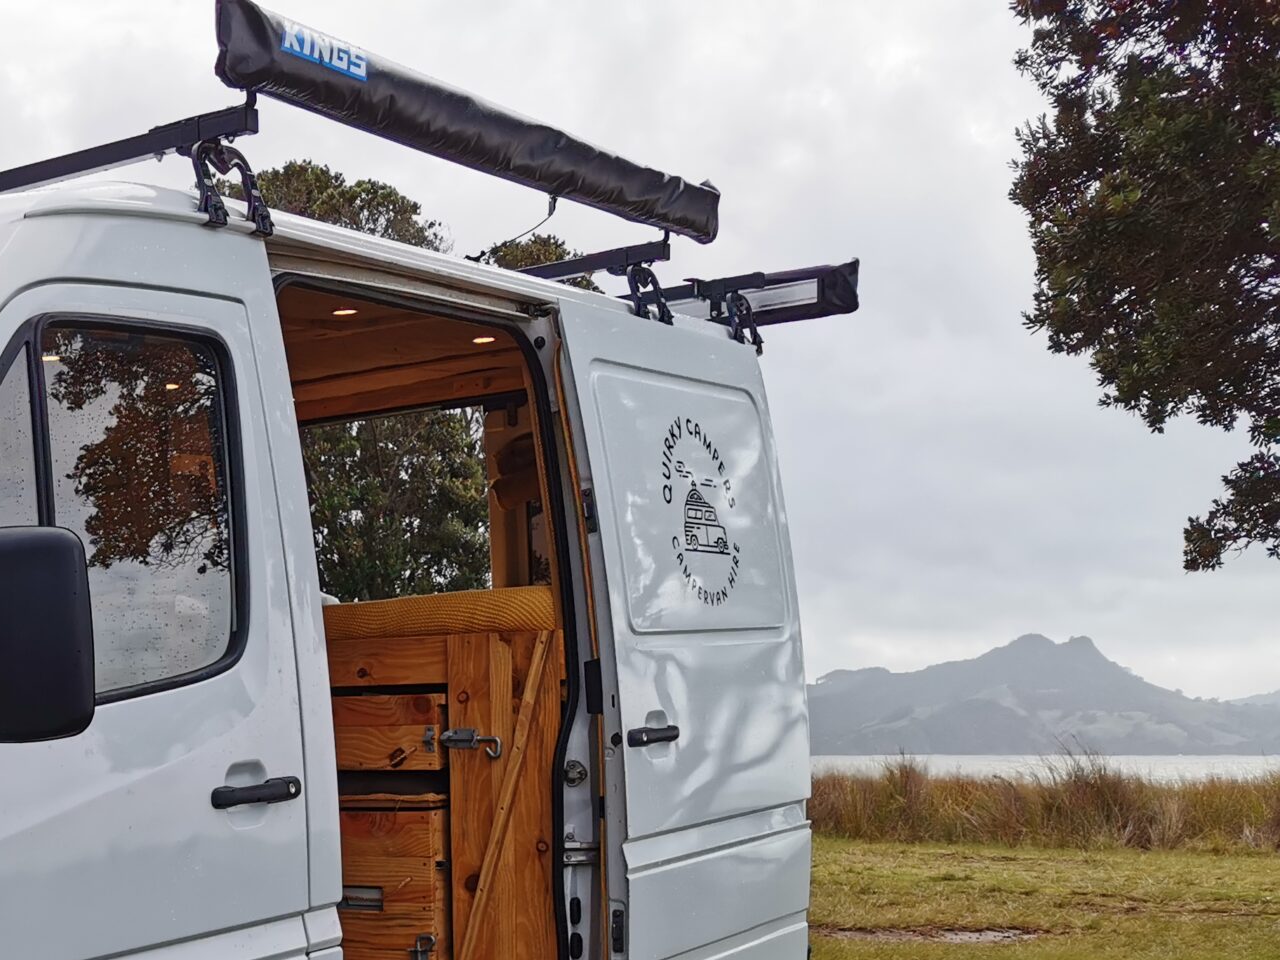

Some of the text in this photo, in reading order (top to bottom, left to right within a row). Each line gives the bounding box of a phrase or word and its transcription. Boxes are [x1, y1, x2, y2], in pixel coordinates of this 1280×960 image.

[282, 23, 367, 77] KINGS
[662, 416, 736, 509] QUIRKY CAMPERS
[672, 536, 740, 606] CAMPERVAN HIRE
